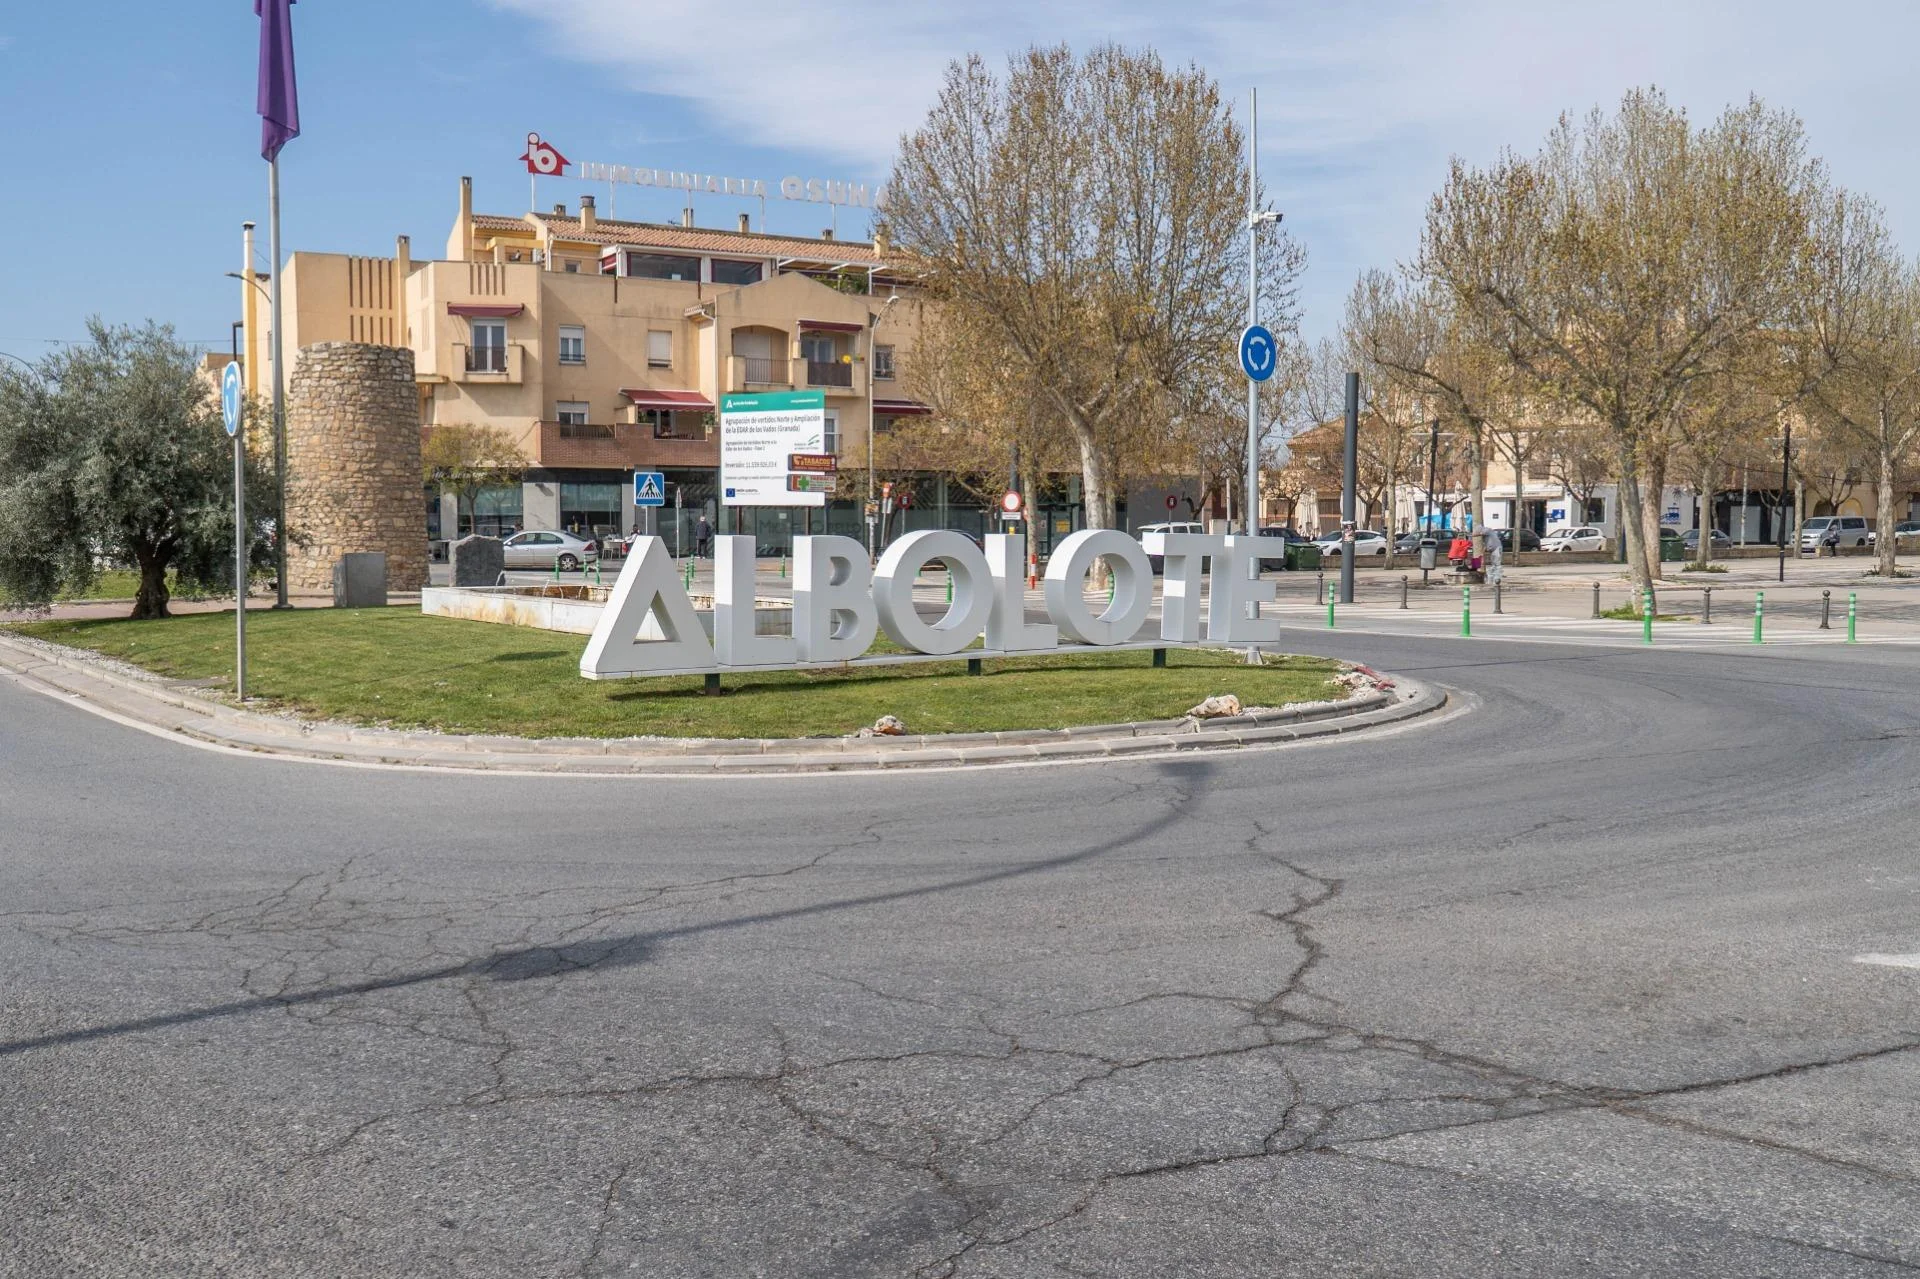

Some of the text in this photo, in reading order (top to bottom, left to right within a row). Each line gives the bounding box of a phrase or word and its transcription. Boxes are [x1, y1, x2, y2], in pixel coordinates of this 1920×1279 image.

[580, 161, 891, 209] INMOBILIARIA OSUNA
[726, 416, 750, 426] Agrupación
[751, 416, 756, 424] de
[580, 530, 1284, 678] ALBOLOTE
